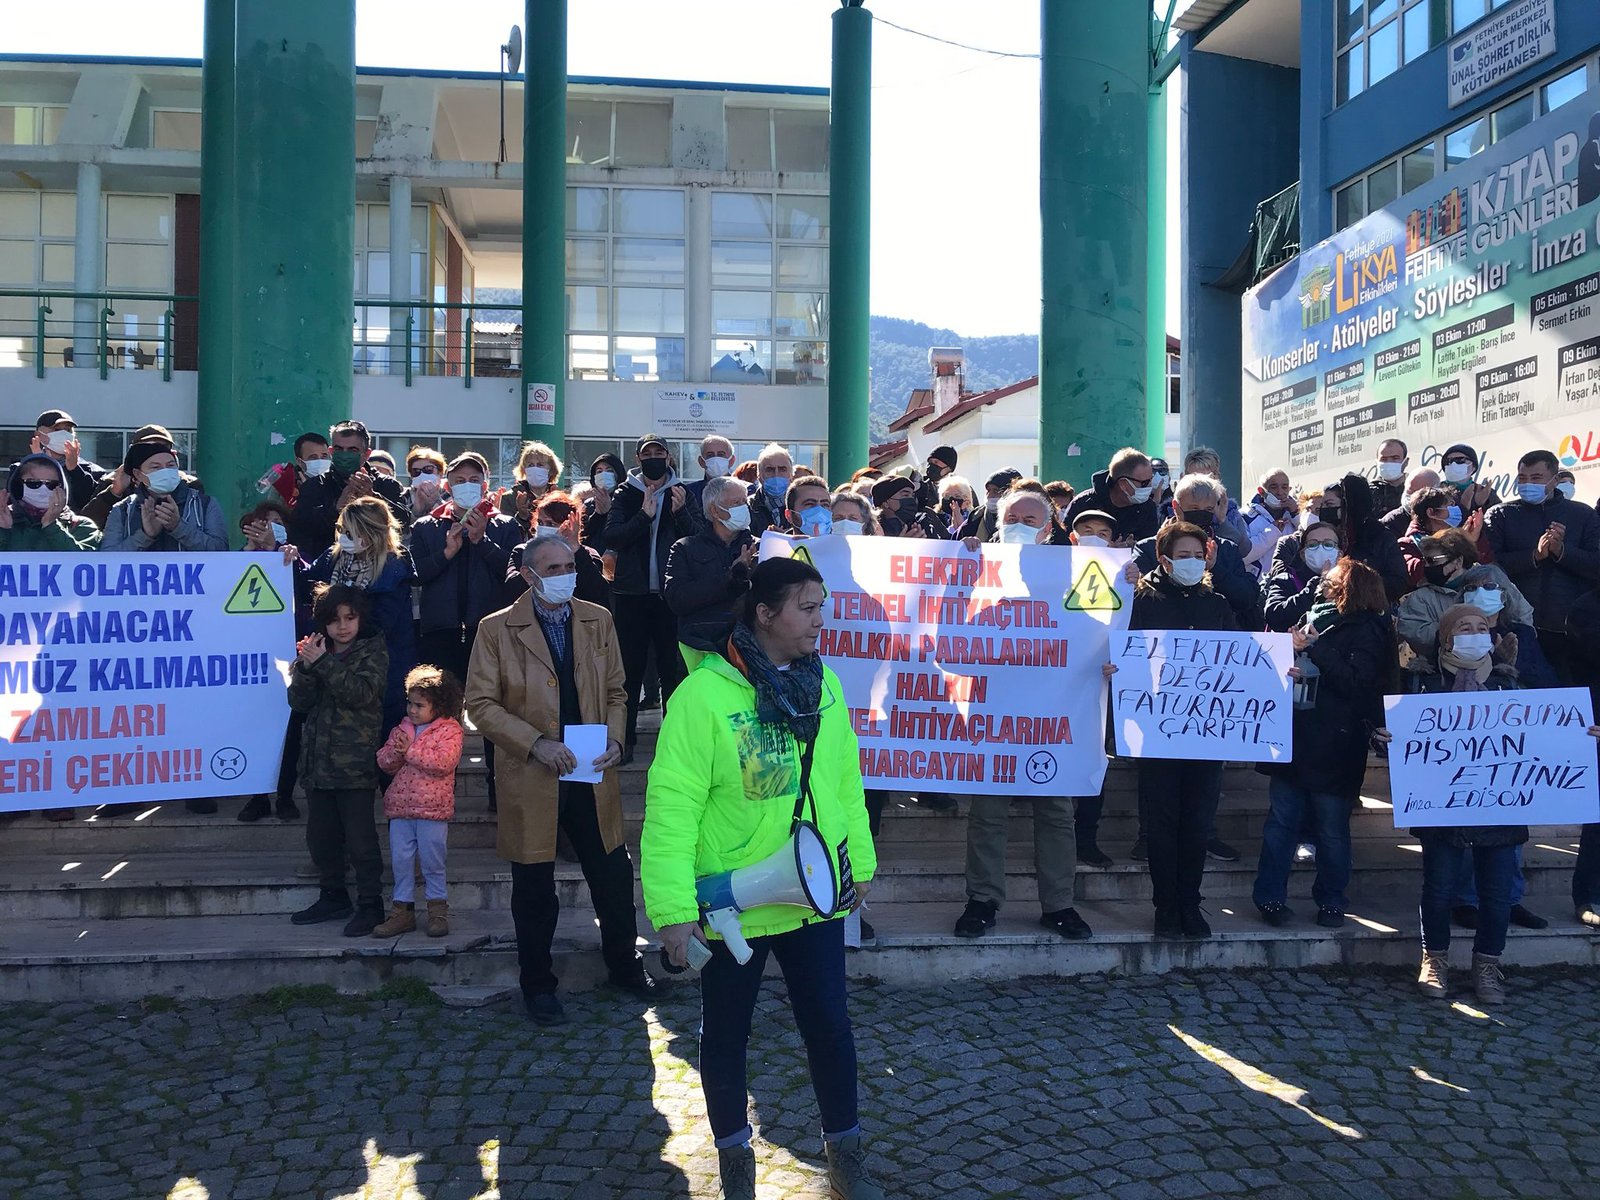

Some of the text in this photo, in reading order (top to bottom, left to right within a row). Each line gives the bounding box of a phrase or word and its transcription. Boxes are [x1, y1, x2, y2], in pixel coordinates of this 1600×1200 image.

[1475, 19, 1505, 43] FETHİYE
[1477, 4, 1547, 53] KÜLTÜR MERKEZİ
[1451, 19, 1551, 86] ÜNAL ŞÖHRET DİRLİK
[1462, 40, 1540, 96] KÜTÜPHANESİ
[1344, 228, 1393, 264] Fethiye 2021
[1263, 337, 1320, 381] Konserler
[1331, 305, 1399, 353] Atölyeler
[1414, 258, 1512, 320] Söyleşiler
[1531, 227, 1587, 274] İmza
[1360, 277, 1398, 305] Etkinlikleri
[1535, 298, 1546, 312] 05
[1547, 290, 1568, 308] Ekim
[1574, 277, 1598, 296] 18:00
[1435, 333, 1445, 347] 03
[1445, 329, 1462, 343] Ekim
[1467, 318, 1487, 335] 17:00
[1538, 304, 1591, 331] Sermet Erkin
[1376, 355, 1385, 367] 02
[1385, 351, 1400, 364] Ekim
[1403, 342, 1420, 358] 21:00
[1437, 350, 1456, 365] Latife
[1457, 343, 1475, 358] Tekin
[1480, 336, 1499, 351] Barış
[1500, 328, 1516, 344] İnce
[1562, 344, 1597, 364] 09 Ekim
[1334, 370, 1346, 381] Ekim
[1378, 368, 1397, 382] Levent
[1437, 355, 1487, 379] Haydar Ergülen
[1479, 375, 1489, 388] 09
[1490, 371, 1508, 385] Ekim
[1514, 361, 1536, 378] 16:00
[1565, 370, 1586, 386] İrfan
[1411, 394, 1419, 407] 07
[1420, 391, 1435, 405] Ekim
[1439, 383, 1459, 400] 20:00
[1481, 390, 1520, 410] İpek Özbey
[1481, 400, 1535, 423] Elfin Tataroğlu
[1565, 388, 1590, 403] Yaşar
[1343, 414, 1355, 426] Ekim
[1386, 419, 1397, 431] Aral
[1413, 411, 1429, 424] Fatih
[73, 562, 205, 597] OLARAK
[889, 553, 1003, 587] ELEKTRİK
[830, 589, 1059, 630] TEMEL İHTİYAÇTIR.
[0, 608, 194, 646] AYANACAK
[918, 633, 1069, 668] PARALARINI
[1121, 636, 1274, 670] ELEKTRİK
[89, 652, 269, 691] KALMADI!!!
[896, 672, 988, 704] HALKIN
[10, 703, 166, 744] ZAMLARI
[1118, 689, 1277, 725] FATURALAR
[1414, 698, 1586, 735] BULDUĞUMA
[848, 704, 1073, 746] EL İHTİYAÇLARINA
[859, 747, 1017, 783] HARCAYIN !!!
[1404, 732, 1526, 766] PİŞMAN
[66, 744, 203, 794] ÇEKİN!!!
[1449, 756, 1589, 790] ETTİNİZ
